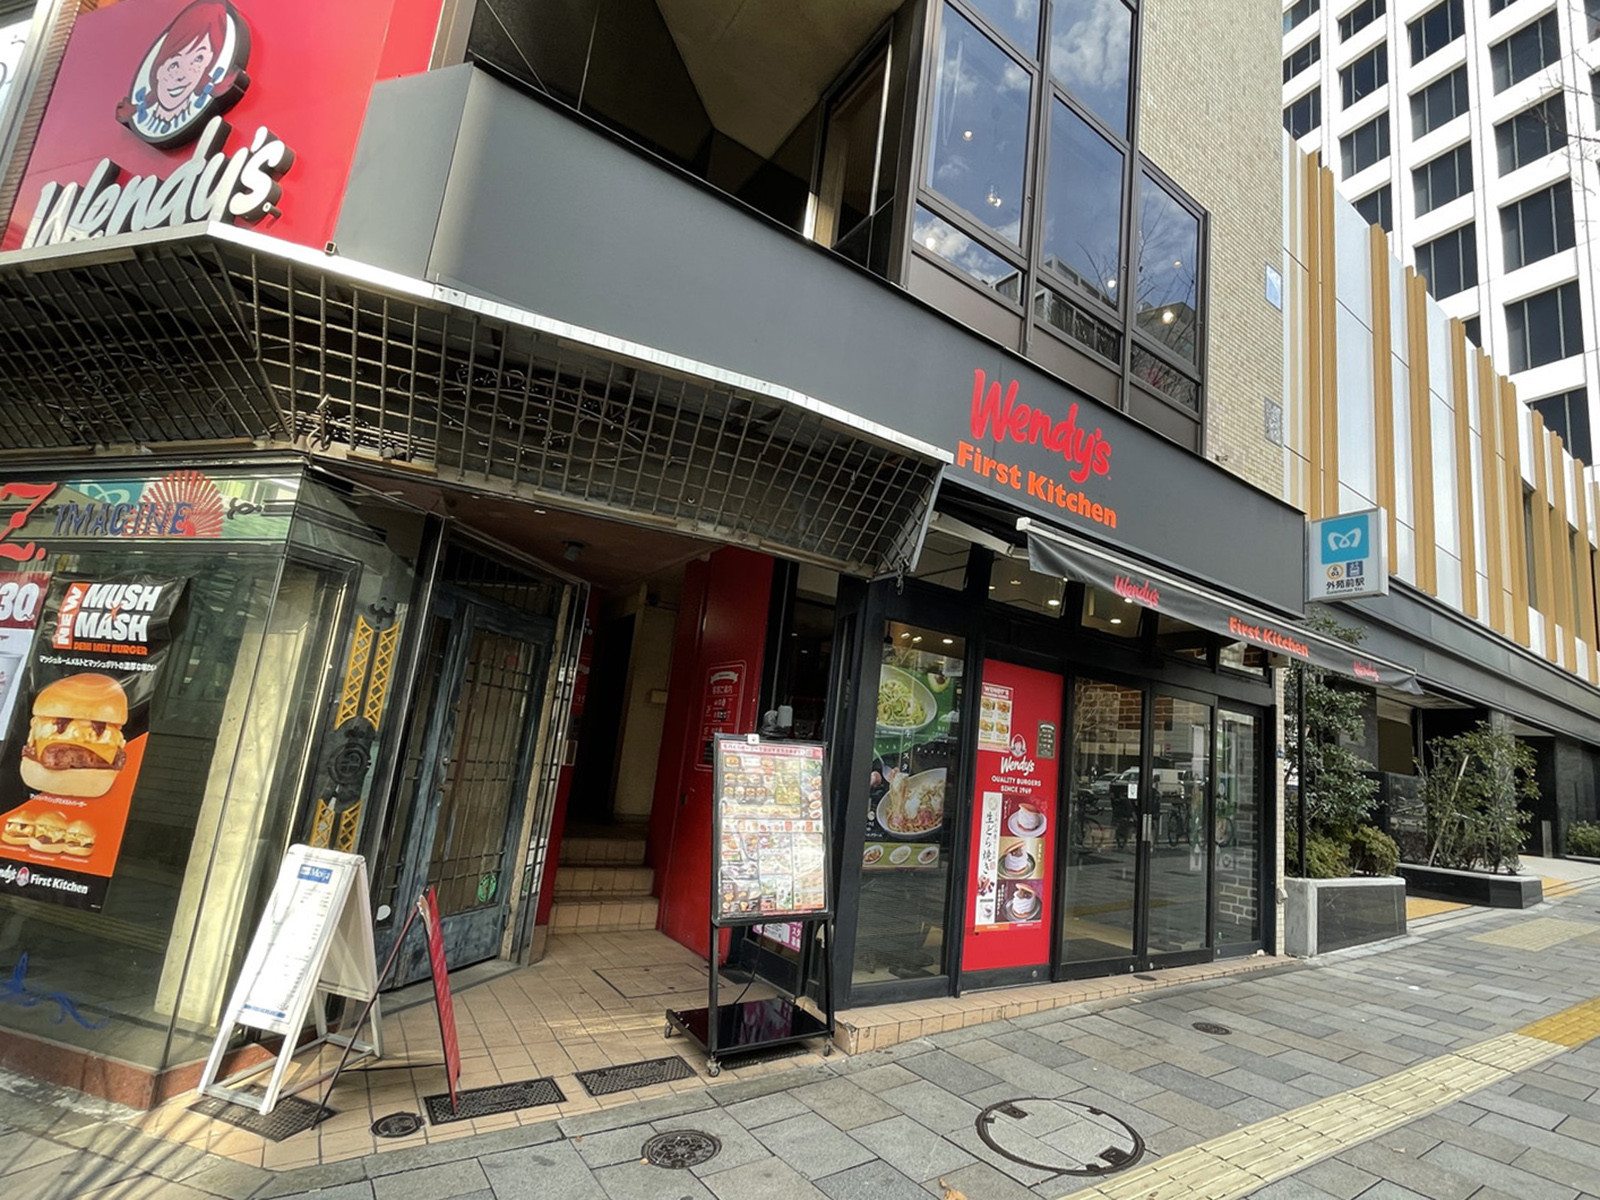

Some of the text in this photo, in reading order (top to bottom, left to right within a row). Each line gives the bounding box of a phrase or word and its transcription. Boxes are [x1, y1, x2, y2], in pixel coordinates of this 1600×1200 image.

[22, 115, 287, 249] Wendy's
[970, 368, 1112, 484] Wendy's
[957, 440, 1118, 529] First Kitchen
[52, 500, 195, 536] IMAGINE
[82, 584, 163, 611] MUSH
[1114, 575, 1160, 607] Wendy's
[1326, 577, 1365, 589] 外苑前駅
[57, 586, 82, 645] NEW
[75, 611, 150, 642] MASH
[112, 645, 148, 655] BURGER
[1229, 617, 1309, 657] First Kitchen
[991, 775, 1041, 787] QUALITY BURGERS
[1001, 756, 1035, 776] Wendy's
[1000, 785, 1018, 793] SINCE
[30, 874, 51, 887] First
[52, 878, 89, 894] Kitchen
